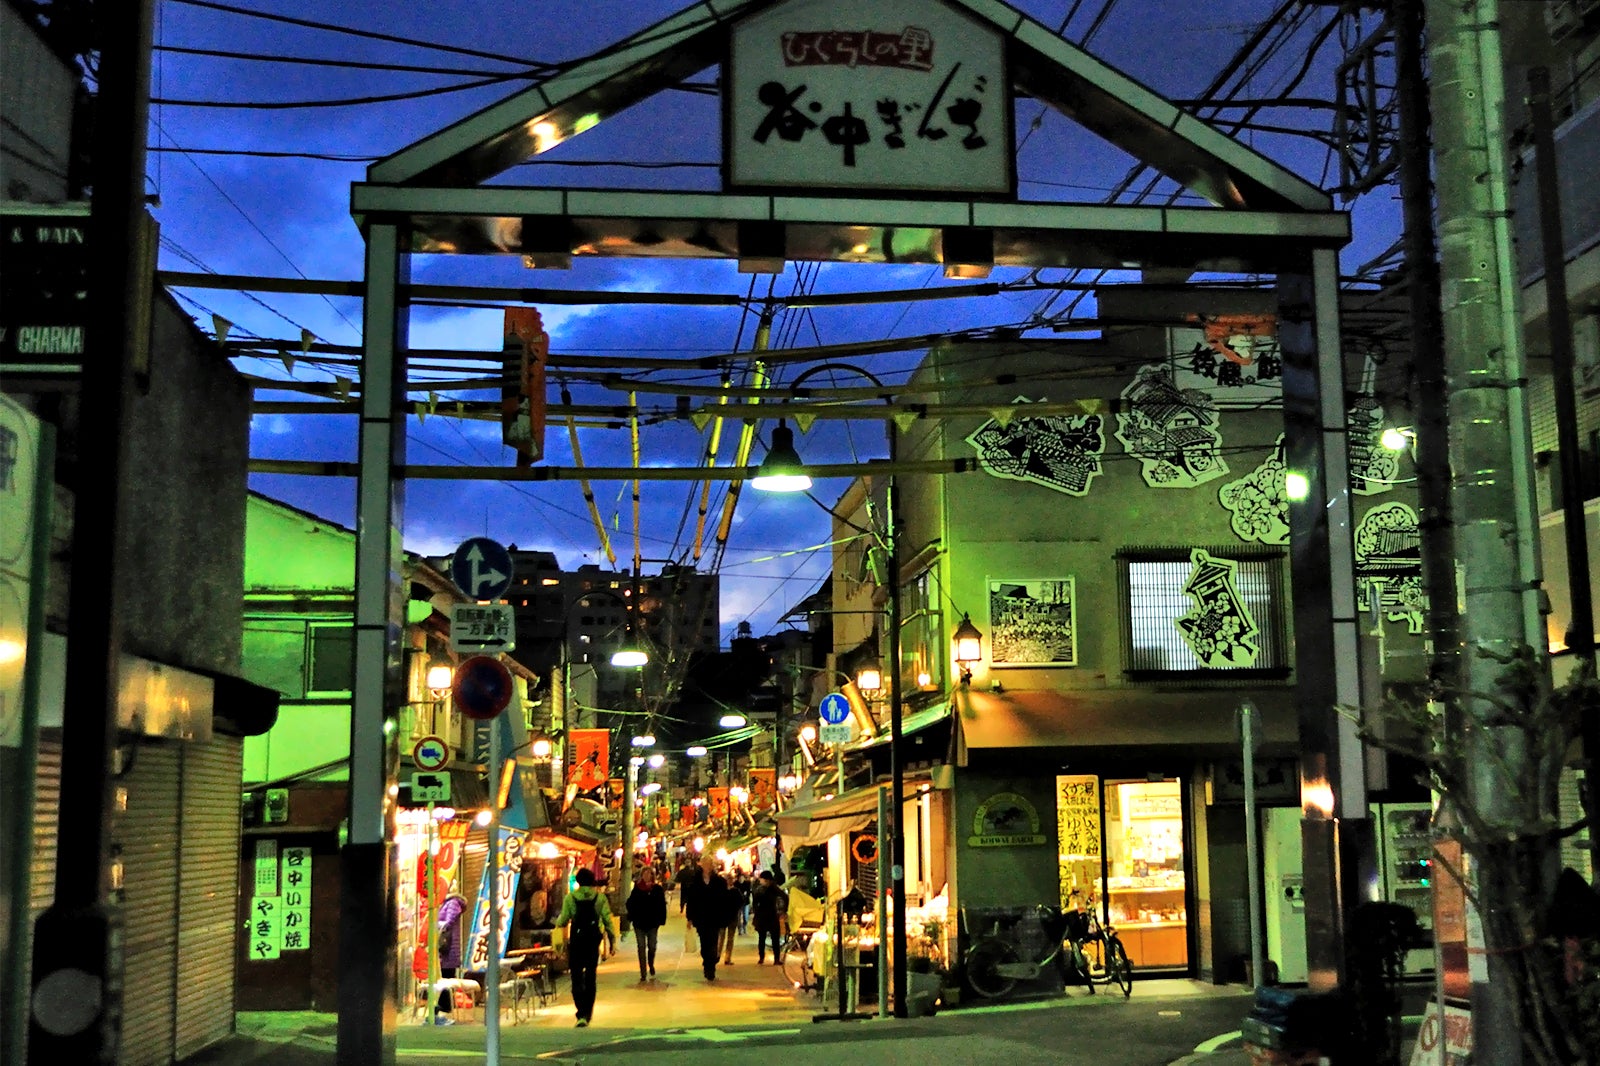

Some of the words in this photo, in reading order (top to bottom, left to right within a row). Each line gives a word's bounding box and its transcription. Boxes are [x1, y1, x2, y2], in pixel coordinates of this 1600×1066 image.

[782, 26, 933, 72] ひぐらしの里
[753, 62, 987, 167] 谷中ぎんざ
[11, 228, 22, 243] &
[285, 849, 304, 948] 谷中いか焼
[256, 900, 274, 957] やきや
